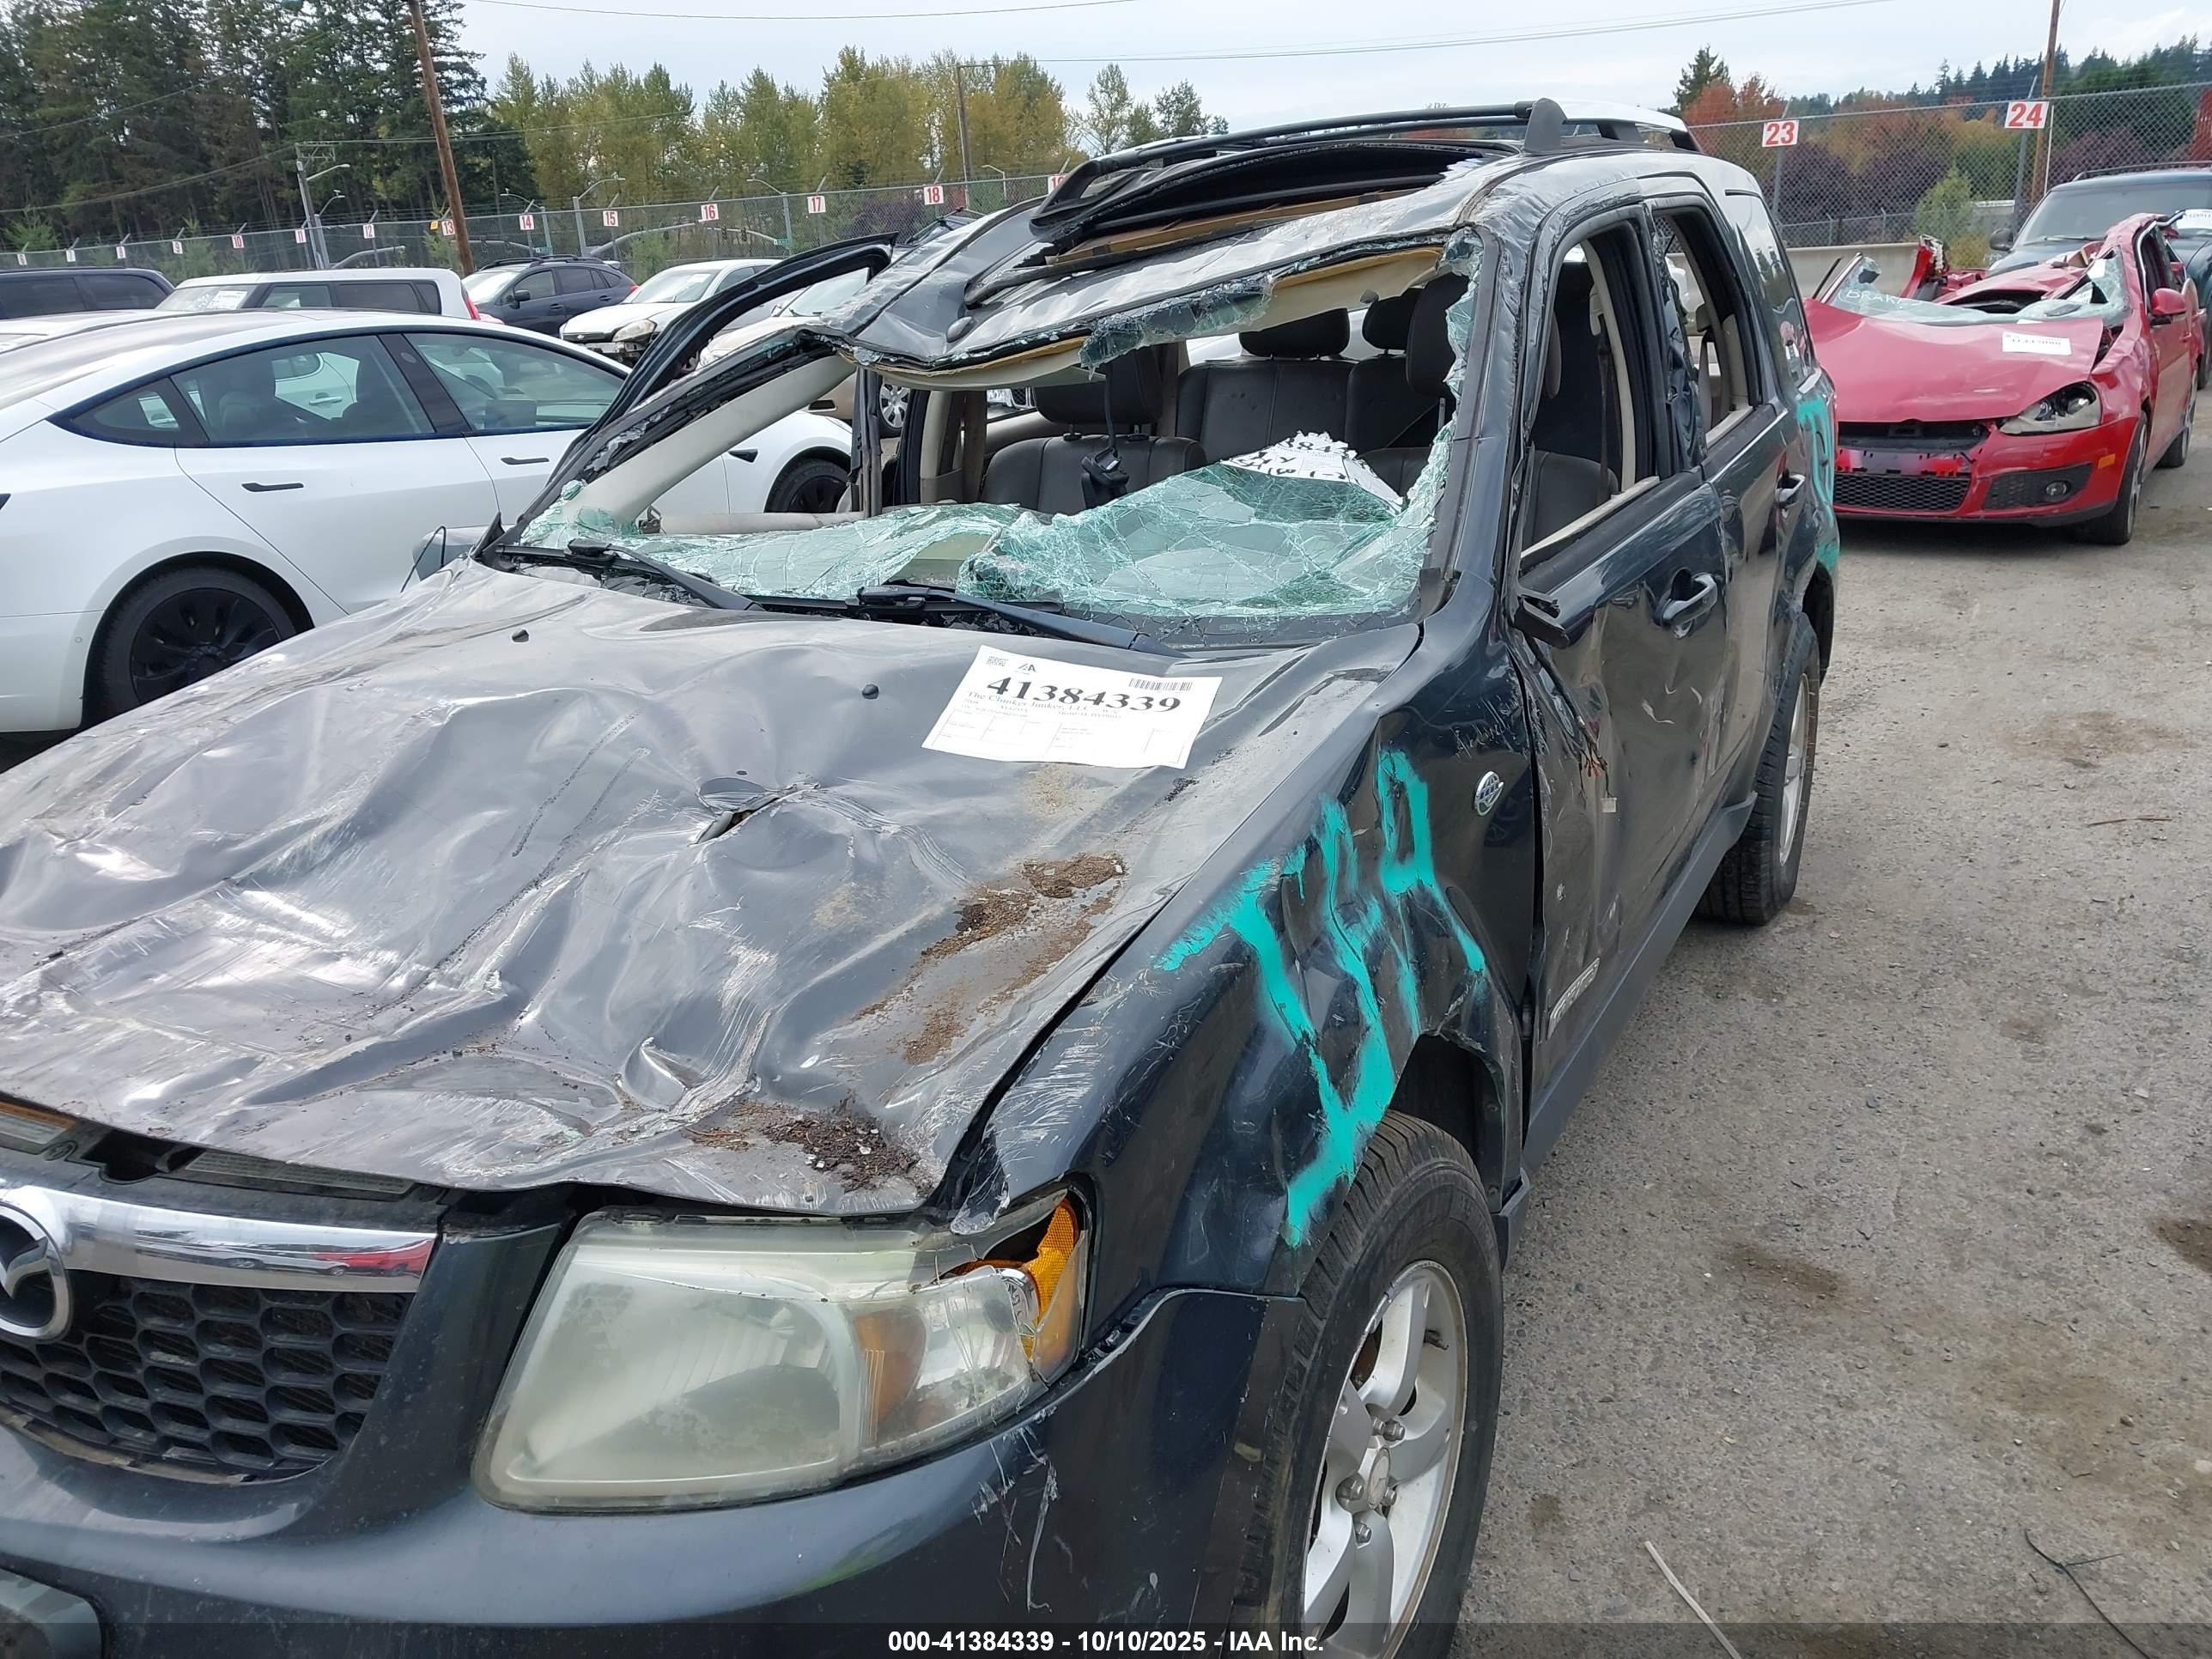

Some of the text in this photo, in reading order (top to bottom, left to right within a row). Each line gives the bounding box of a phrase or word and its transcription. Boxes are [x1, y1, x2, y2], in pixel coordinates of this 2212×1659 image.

[2008, 102, 2043, 127] 24
[1765, 121, 1796, 145] 23
[926, 186, 940, 204] 18
[703, 204, 716, 220] 16
[811, 197, 822, 212] 17
[520, 215, 532, 229] 14
[605, 211, 617, 226] 15
[364, 224, 374, 238] 12
[444, 222, 454, 234] 13
[234, 235, 242, 248] 10
[296, 229, 305, 243] 11
[987, 677, 1181, 713] 41384339
